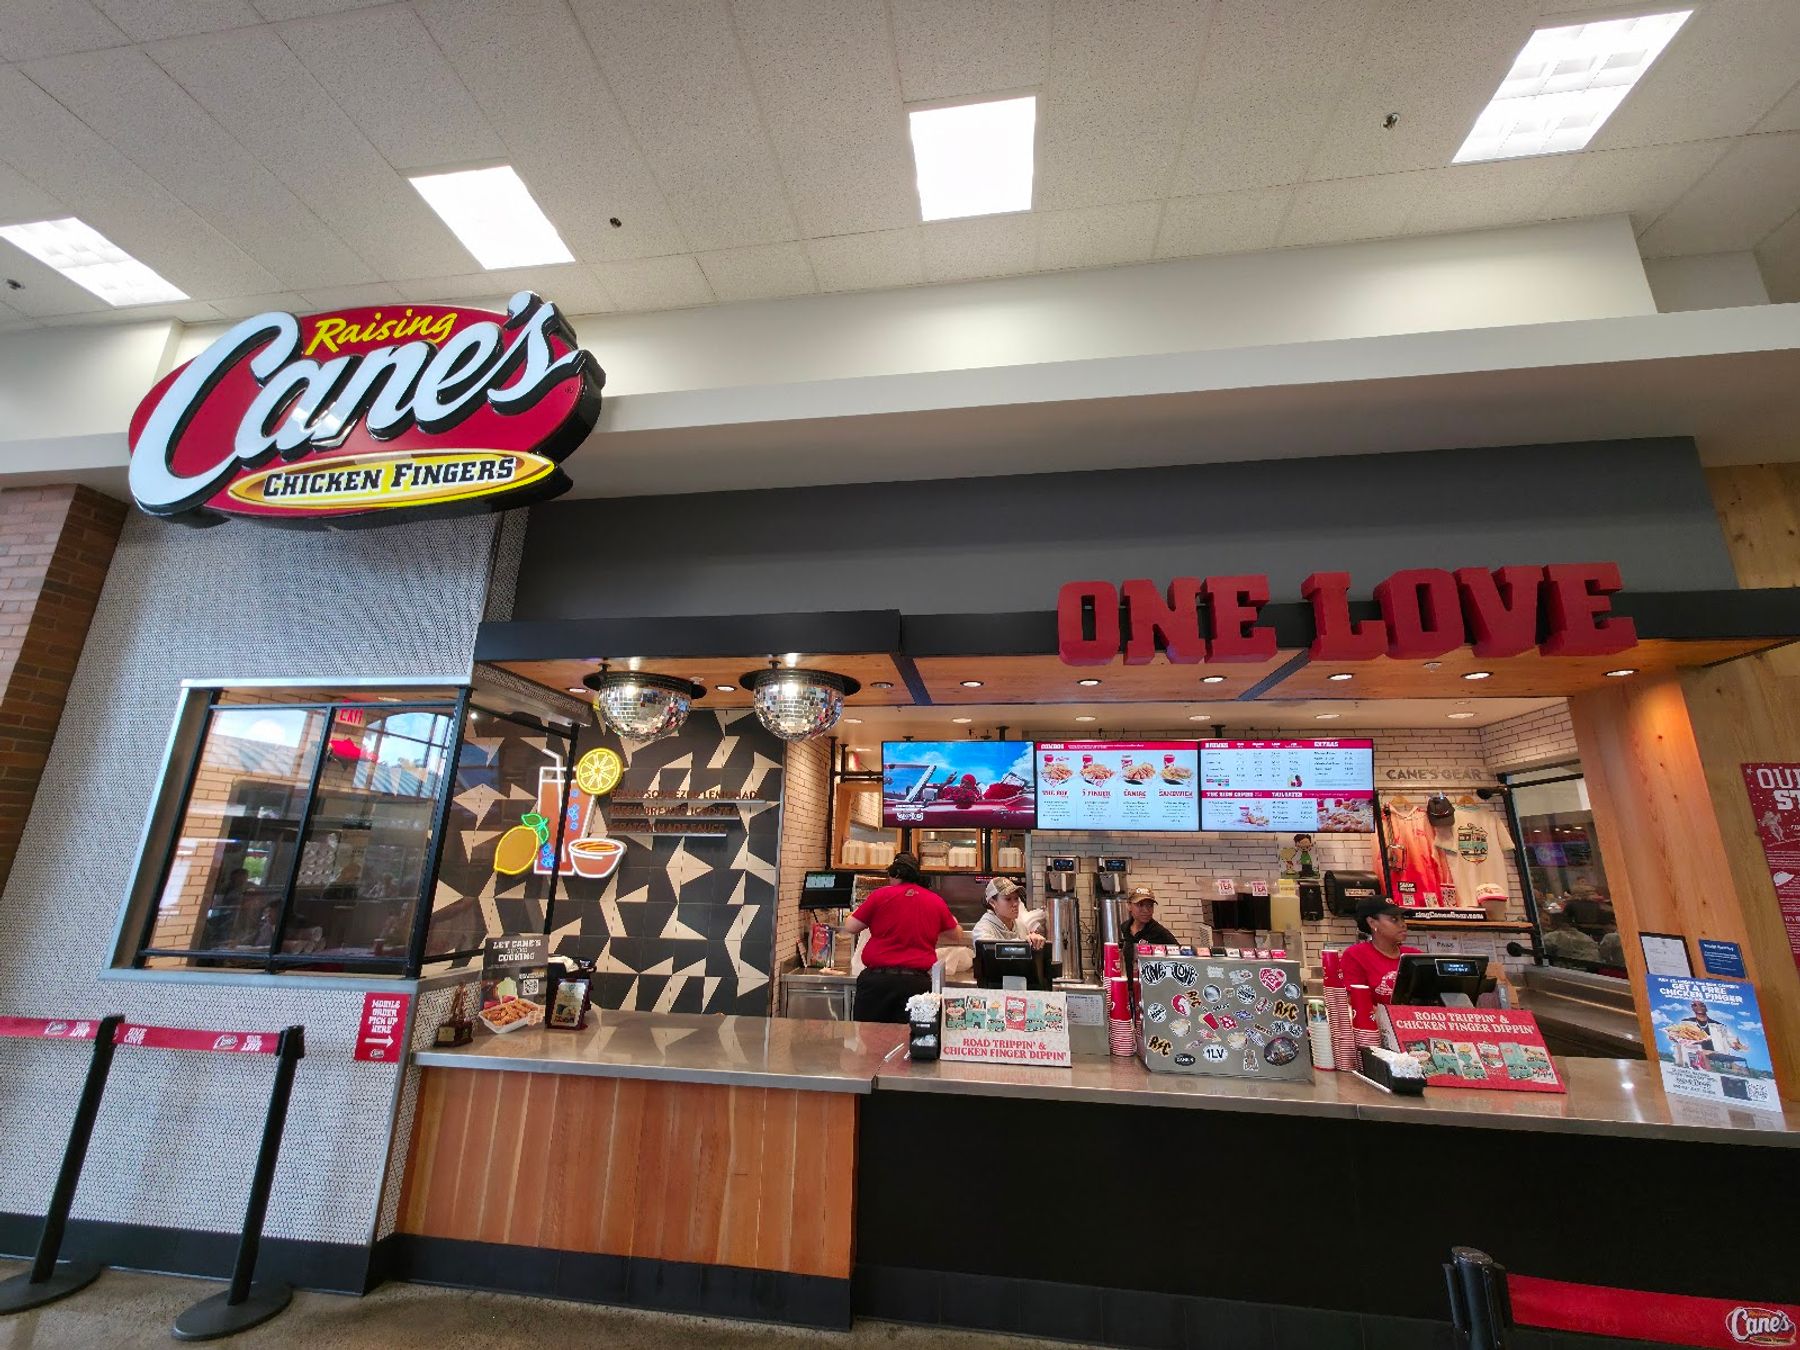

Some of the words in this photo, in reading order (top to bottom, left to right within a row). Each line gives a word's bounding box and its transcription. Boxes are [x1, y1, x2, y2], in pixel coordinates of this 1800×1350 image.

[305, 308, 457, 355] Raising
[128, 290, 585, 508] Cane's
[263, 468, 383, 502] CHICKEN
[391, 455, 516, 493] FINGERS
[1057, 574, 1279, 666] ONE
[1300, 561, 1639, 662] LOVE
[492, 940, 510, 950] LET
[498, 952, 535, 962] COOKING
[1659, 987, 1704, 999] CHICKEN
[1413, 1011, 1446, 1021] ROAD
[1447, 1012, 1496, 1024] TRIPPIN'
[1499, 1014, 1510, 1024] &
[1396, 1018, 1446, 1031] CHICKEN
[1448, 1020, 1488, 1033] FINGER
[1488, 1022, 1534, 1034] DIPPIN'
[963, 1038, 991, 1048] ROAD
[992, 1040, 1038, 1050] TRIPPIN'
[1038, 1041, 1047, 1051] &
[943, 1047, 988, 1057] CHICKEN
[990, 1048, 1027, 1059] FINGER
[1028, 1050, 1067, 1061] DIPPIN'
[1206, 1048, 1224, 1059] 1LV
[1731, 1307, 1790, 1341] Cane's
